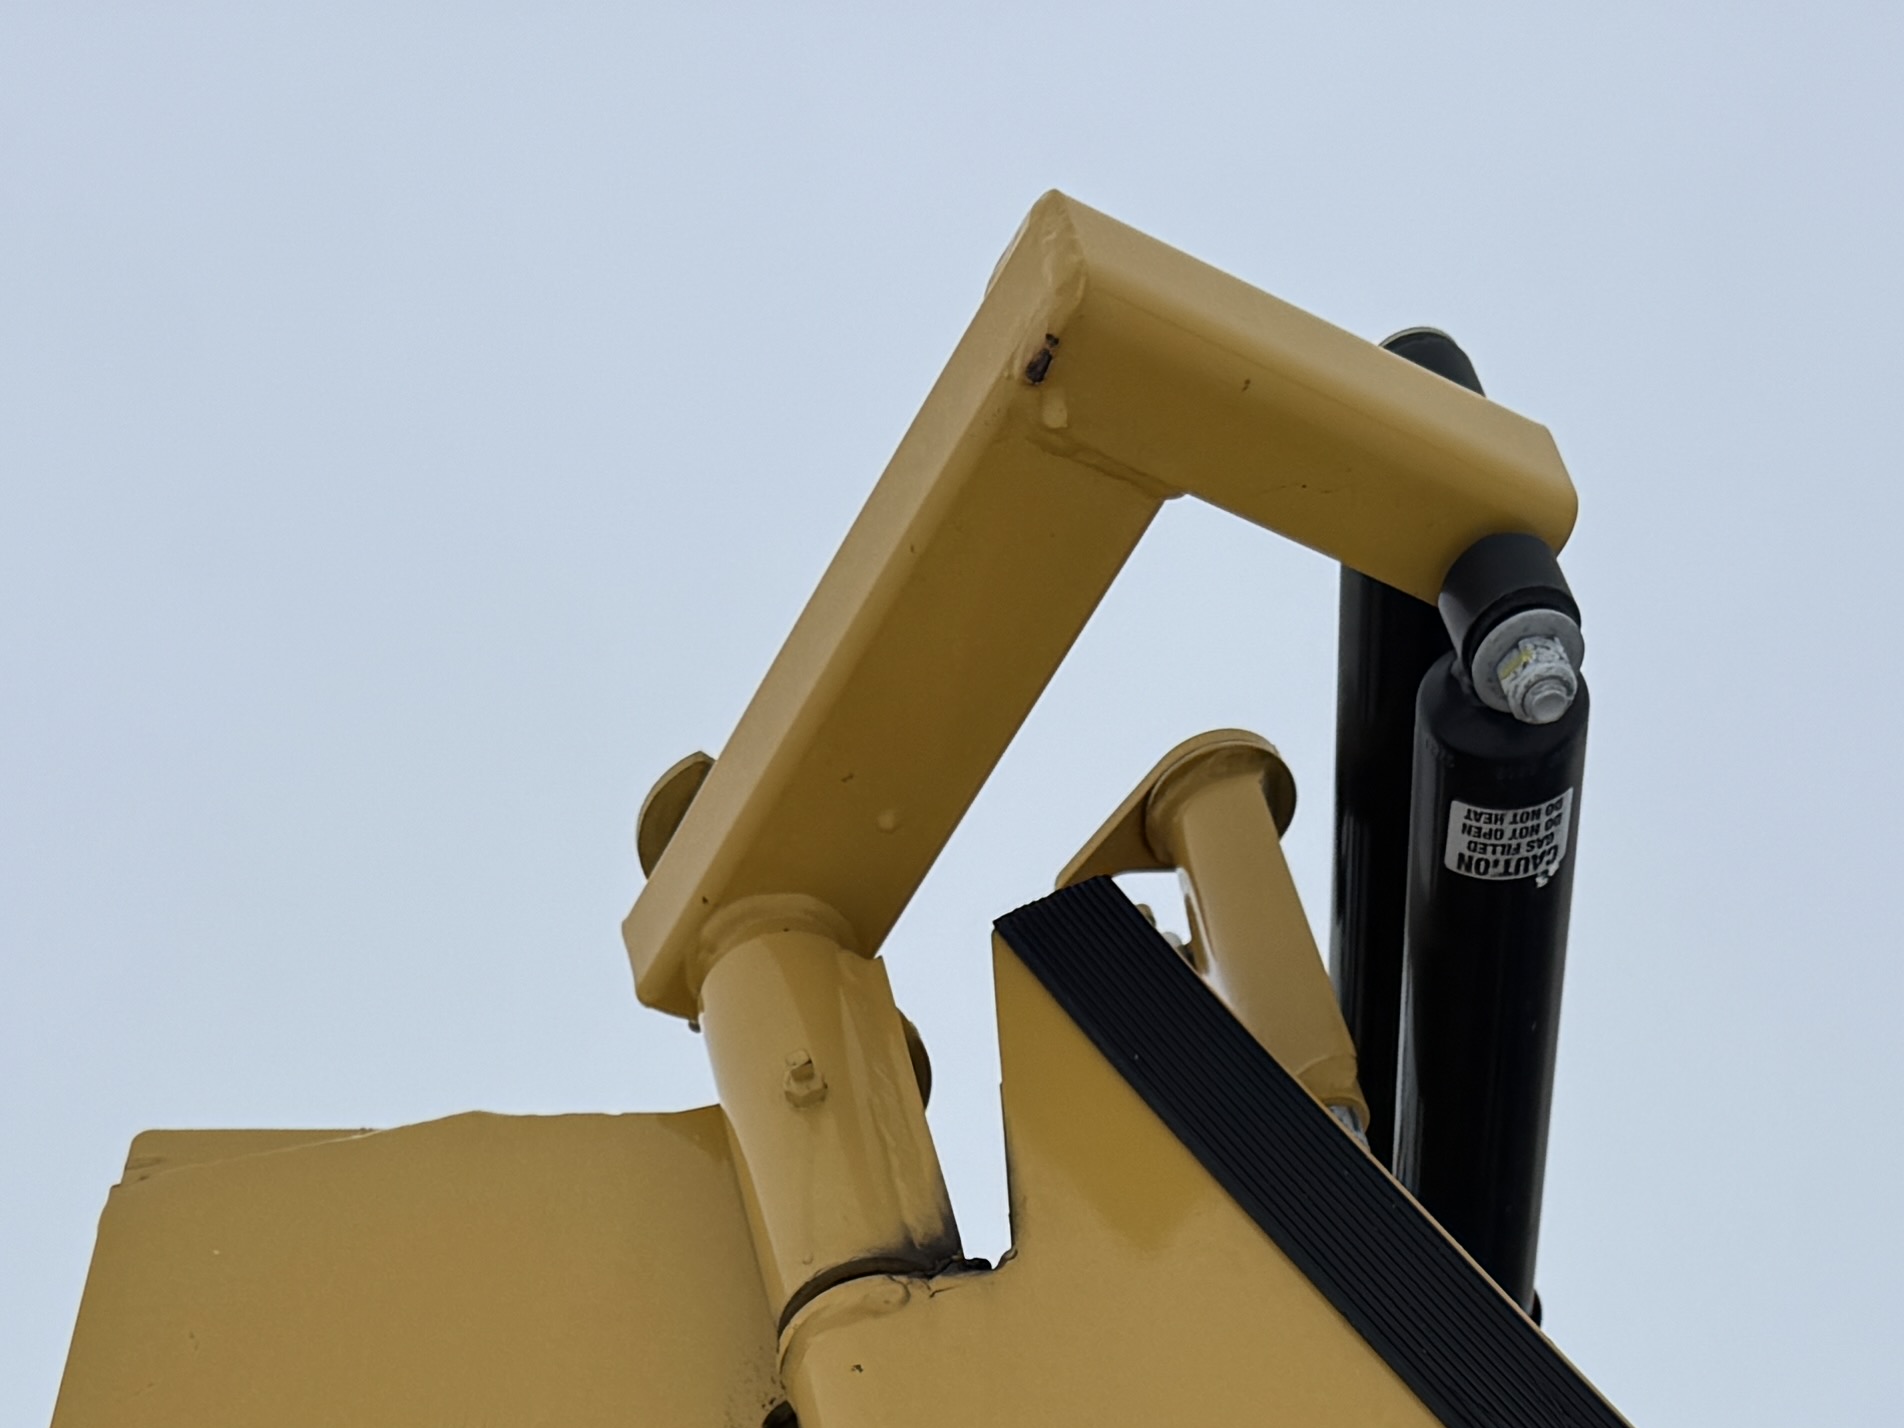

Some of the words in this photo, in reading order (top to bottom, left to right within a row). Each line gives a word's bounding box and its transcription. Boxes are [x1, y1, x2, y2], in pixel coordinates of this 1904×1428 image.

[1508, 807, 1542, 824] NOT
[1544, 797, 1564, 816] DO
[1463, 808, 1506, 825] HEAT
[1544, 813, 1563, 831] DO
[1461, 822, 1505, 841] OPEN
[1508, 823, 1541, 841] NOT
[1467, 840, 1521, 856] FILLED
[1526, 832, 1555, 853] GAS
